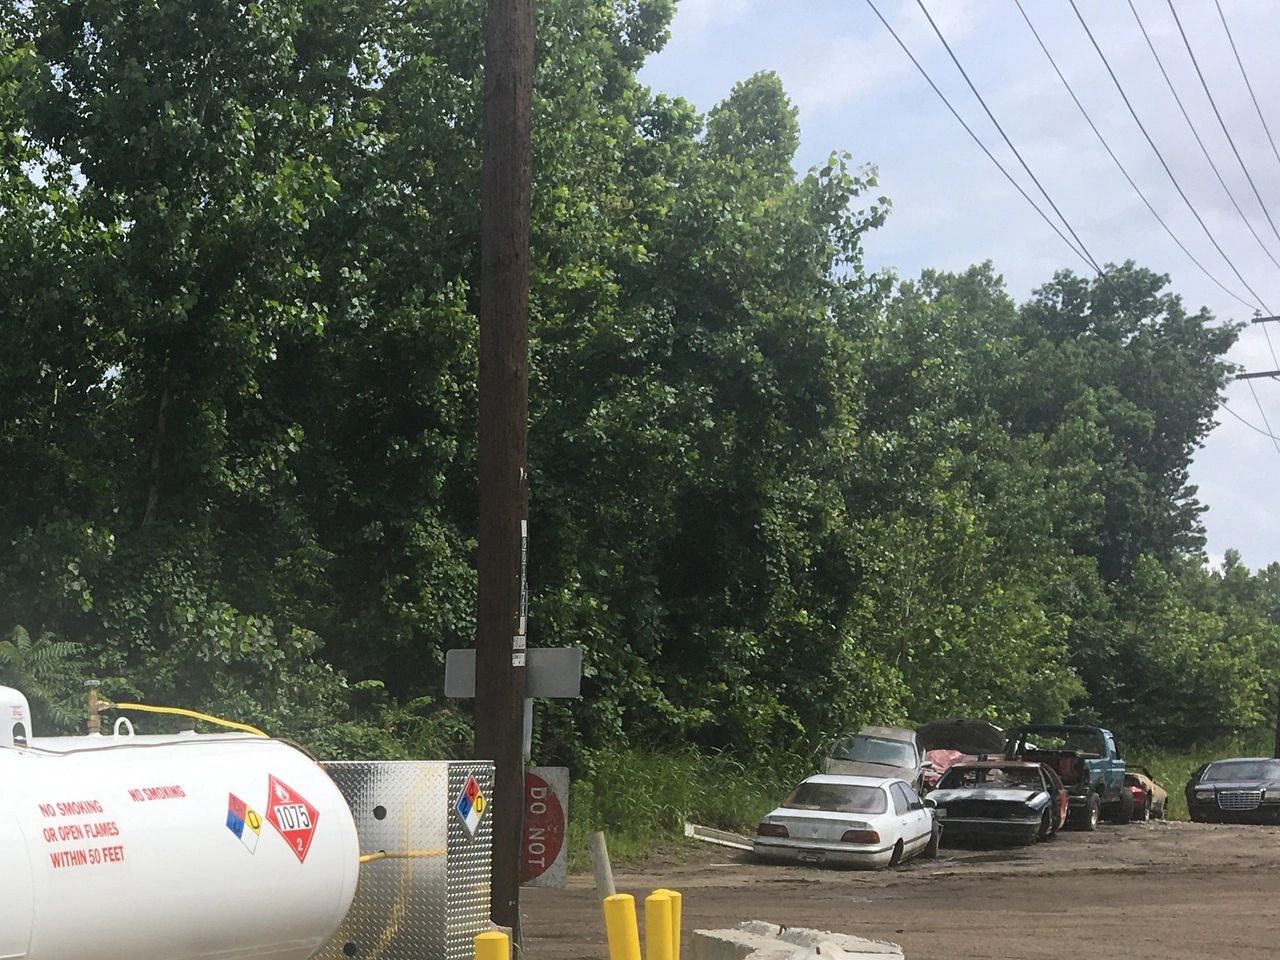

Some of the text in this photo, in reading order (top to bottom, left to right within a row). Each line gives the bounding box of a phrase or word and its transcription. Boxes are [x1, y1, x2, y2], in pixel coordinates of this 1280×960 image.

[128, 785, 186, 802] NO SMOKING
[38, 800, 104, 818] NO SMOKING
[476, 795, 483, 813] 0
[247, 810, 260, 829] 0
[276, 805, 310, 830] 1075
[43, 821, 120, 843] OR OPEN FLAMES
[528, 787, 547, 868] DO NOT
[297, 838, 304, 851] 2
[50, 845, 125, 869] WITHIN 50 FEET
